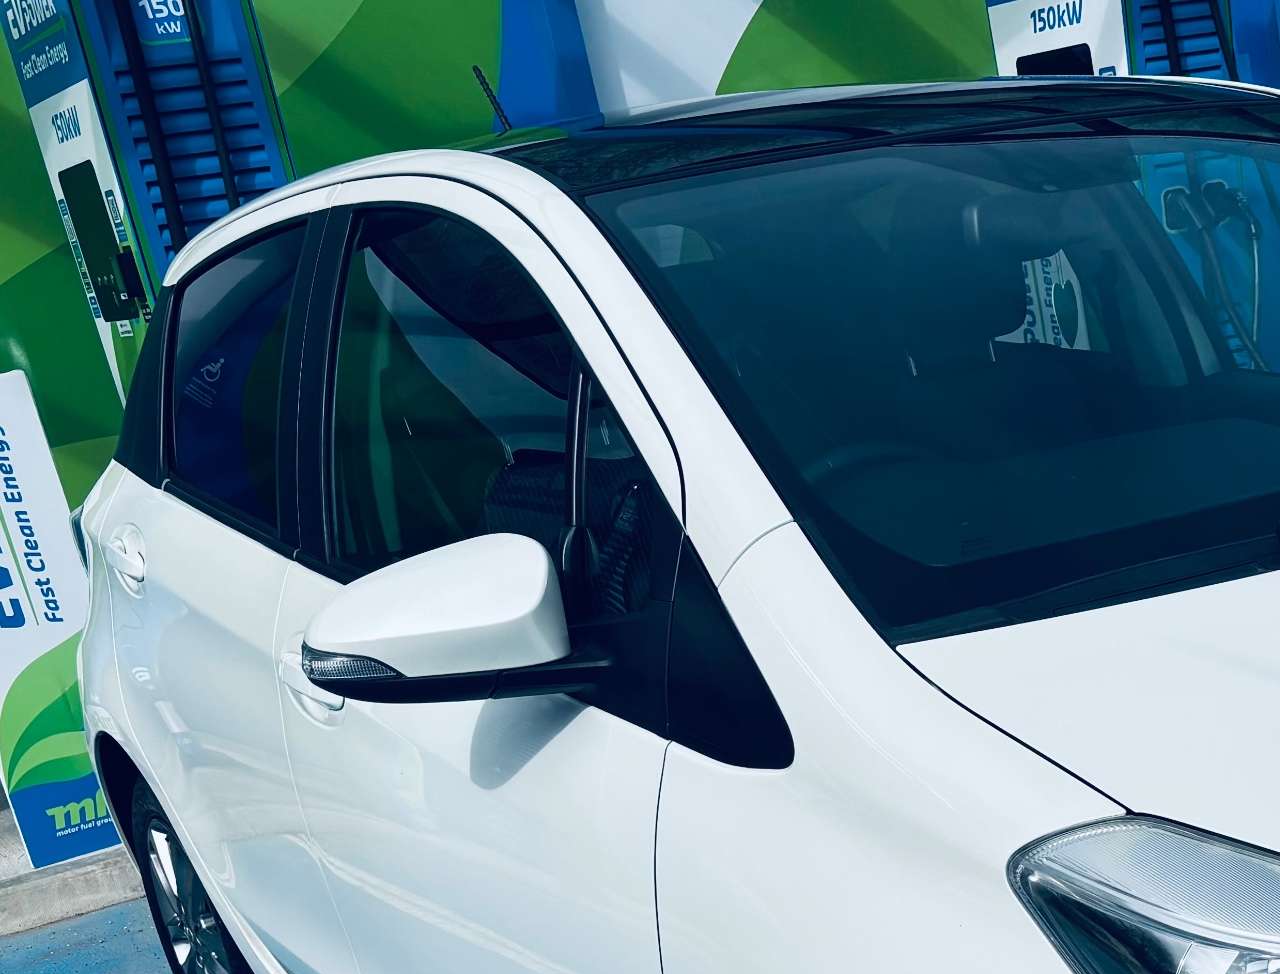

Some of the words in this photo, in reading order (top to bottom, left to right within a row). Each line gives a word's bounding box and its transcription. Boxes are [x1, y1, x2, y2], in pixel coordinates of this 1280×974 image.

[138, 0, 185, 19] 150
[1030, 0, 1083, 34] 150kW
[155, 21, 181, 34] kW
[52, 105, 82, 144] 150kW
[14, 510, 46, 573] Clean
[44, 576, 64, 623] Fast
[56, 826, 80, 837] motor
[80, 820, 95, 830] fuel
